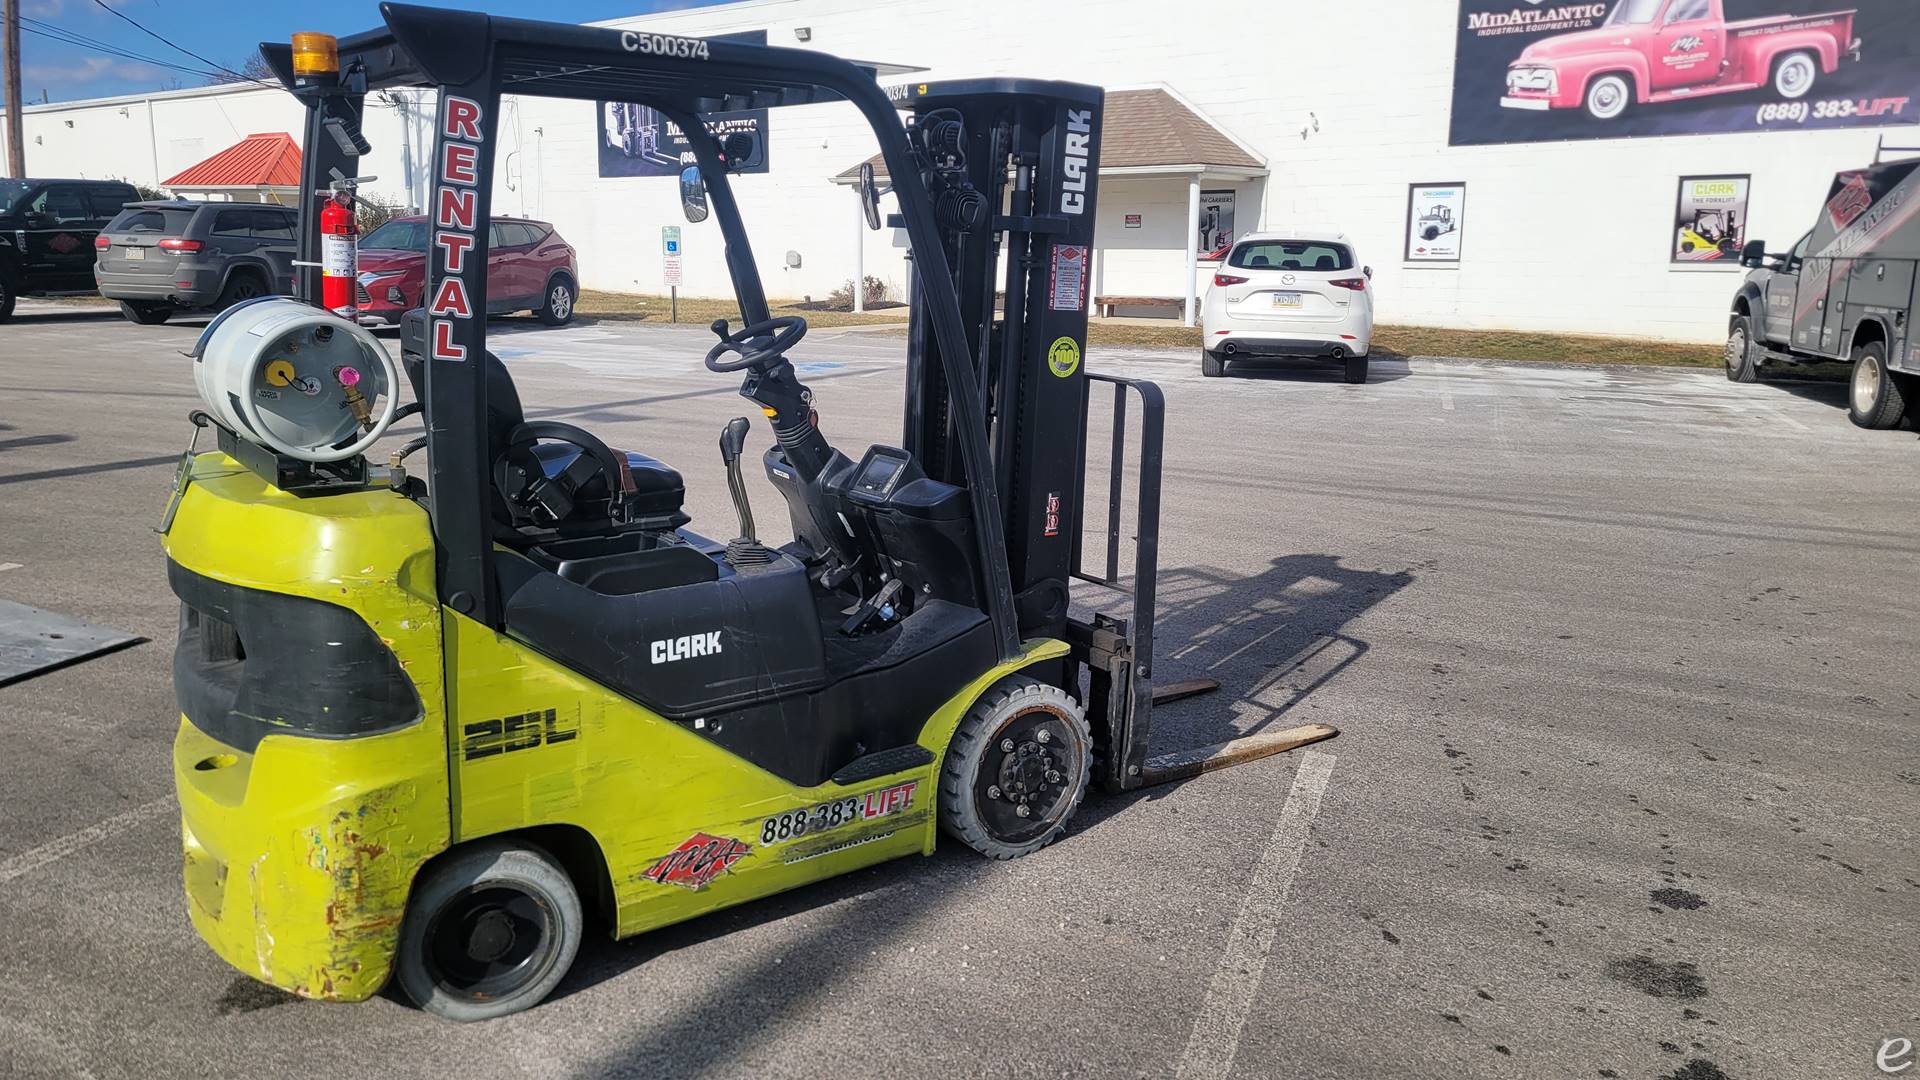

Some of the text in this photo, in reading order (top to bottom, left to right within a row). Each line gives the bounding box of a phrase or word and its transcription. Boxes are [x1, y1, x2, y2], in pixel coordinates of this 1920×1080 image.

[1477, 18, 1593, 37] INDUSTRIAL EQUIPMENT LTD.
[621, 31, 709, 60] C500374
[1756, 97, 1909, 125] (888) 383-LIFT
[1061, 108, 1091, 214] CLARK
[1695, 183, 1735, 195] CLARK
[429, 95, 482, 361] RENTAL
[651, 630, 722, 665] CLARK
